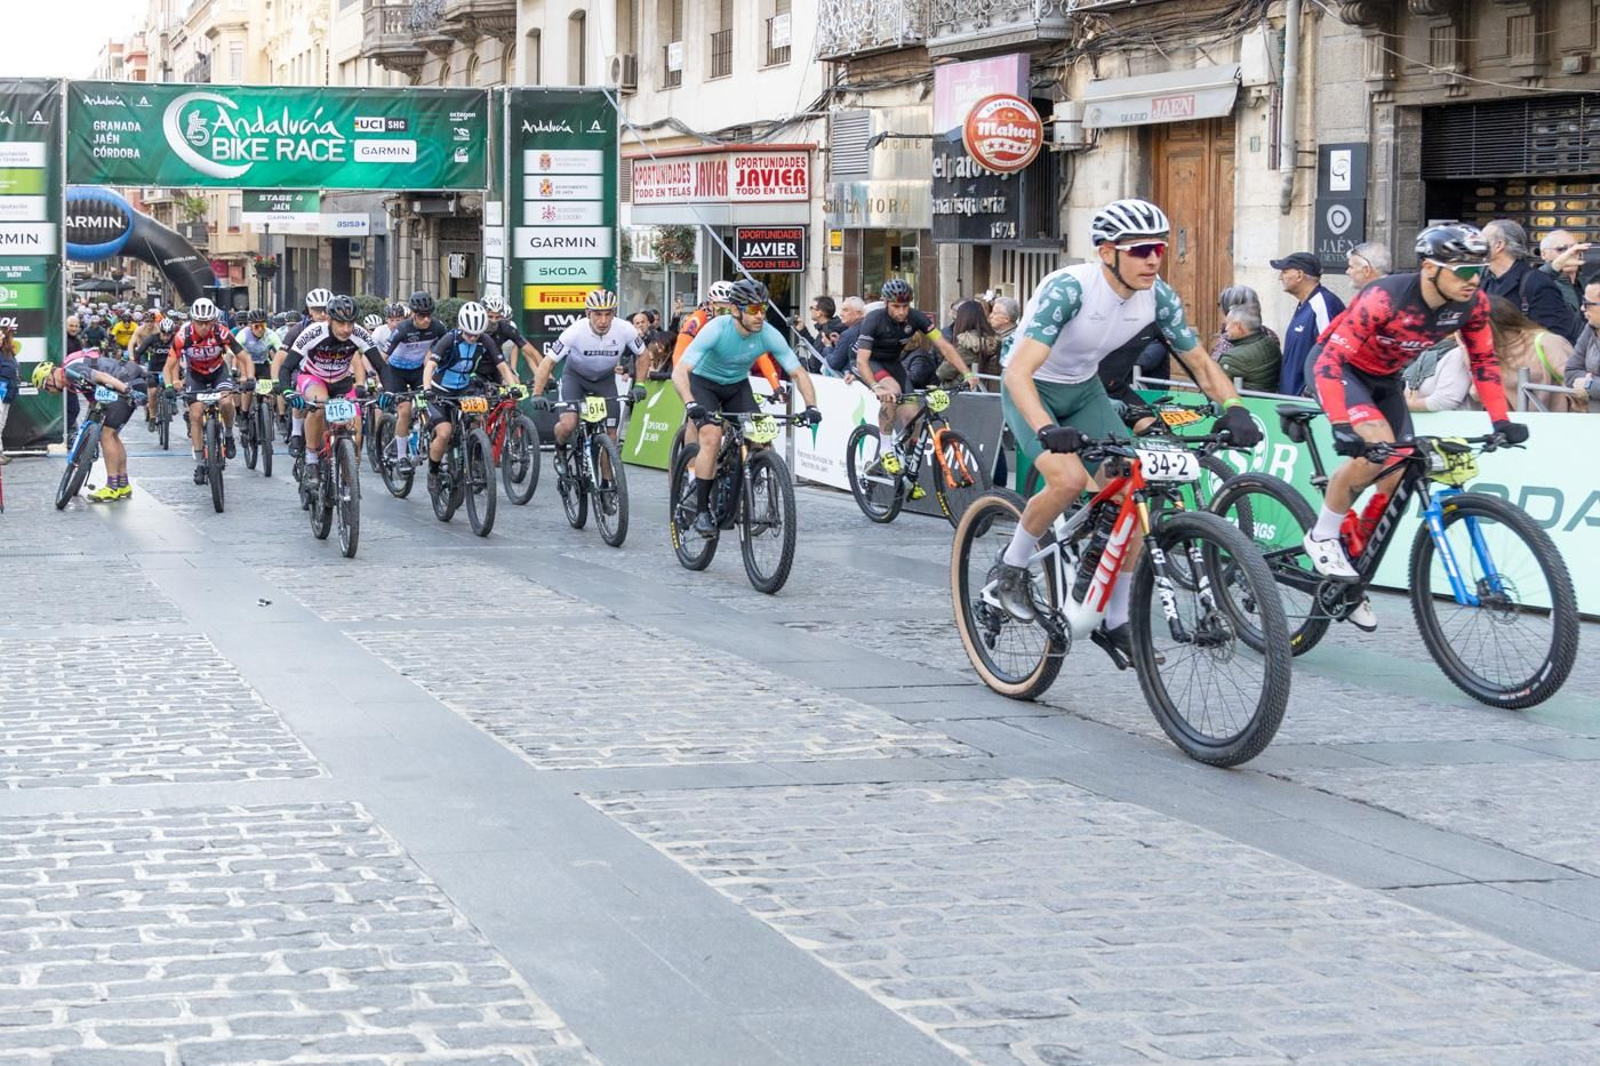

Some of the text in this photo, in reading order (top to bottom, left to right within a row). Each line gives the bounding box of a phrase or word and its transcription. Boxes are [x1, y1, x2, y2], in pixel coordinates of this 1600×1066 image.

[83, 95, 126, 107] Andalucía
[93, 121, 141, 132] GRANADA
[210, 104, 345, 138] Andalucía
[360, 119, 405, 130] UCI SHC
[521, 120, 574, 133] Andalucía
[977, 122, 1036, 139] Mahou
[93, 133, 120, 145] JAÉN
[93, 147, 141, 159] CÓRDOBA
[212, 138, 346, 161] BIKE RACE
[361, 146, 410, 155] GARMIN
[735, 157, 806, 168] OPORTUNIDADES
[635, 163, 691, 186] OPORTUNIDADES
[694, 160, 729, 197] JAVIER
[736, 168, 806, 187] JAVIER
[635, 187, 691, 199] TODO EN TELAS
[763, 187, 775, 195] EN
[779, 186, 807, 194] TELAS
[739, 229, 802, 239] OPORTUNIDADES
[990, 221, 1016, 239] 1974
[530, 237, 596, 248] GARMIN
[743, 242, 797, 256] JAVIER
[164, 255, 197, 266] garmin.com
[765, 260, 776, 268] EN
[540, 291, 587, 303] PIRELLI
[328, 404, 353, 417] 416-1
[589, 401, 605, 414] 614
[1164, 411, 1197, 424] 517-1
[1147, 452, 1189, 476] 34-2
